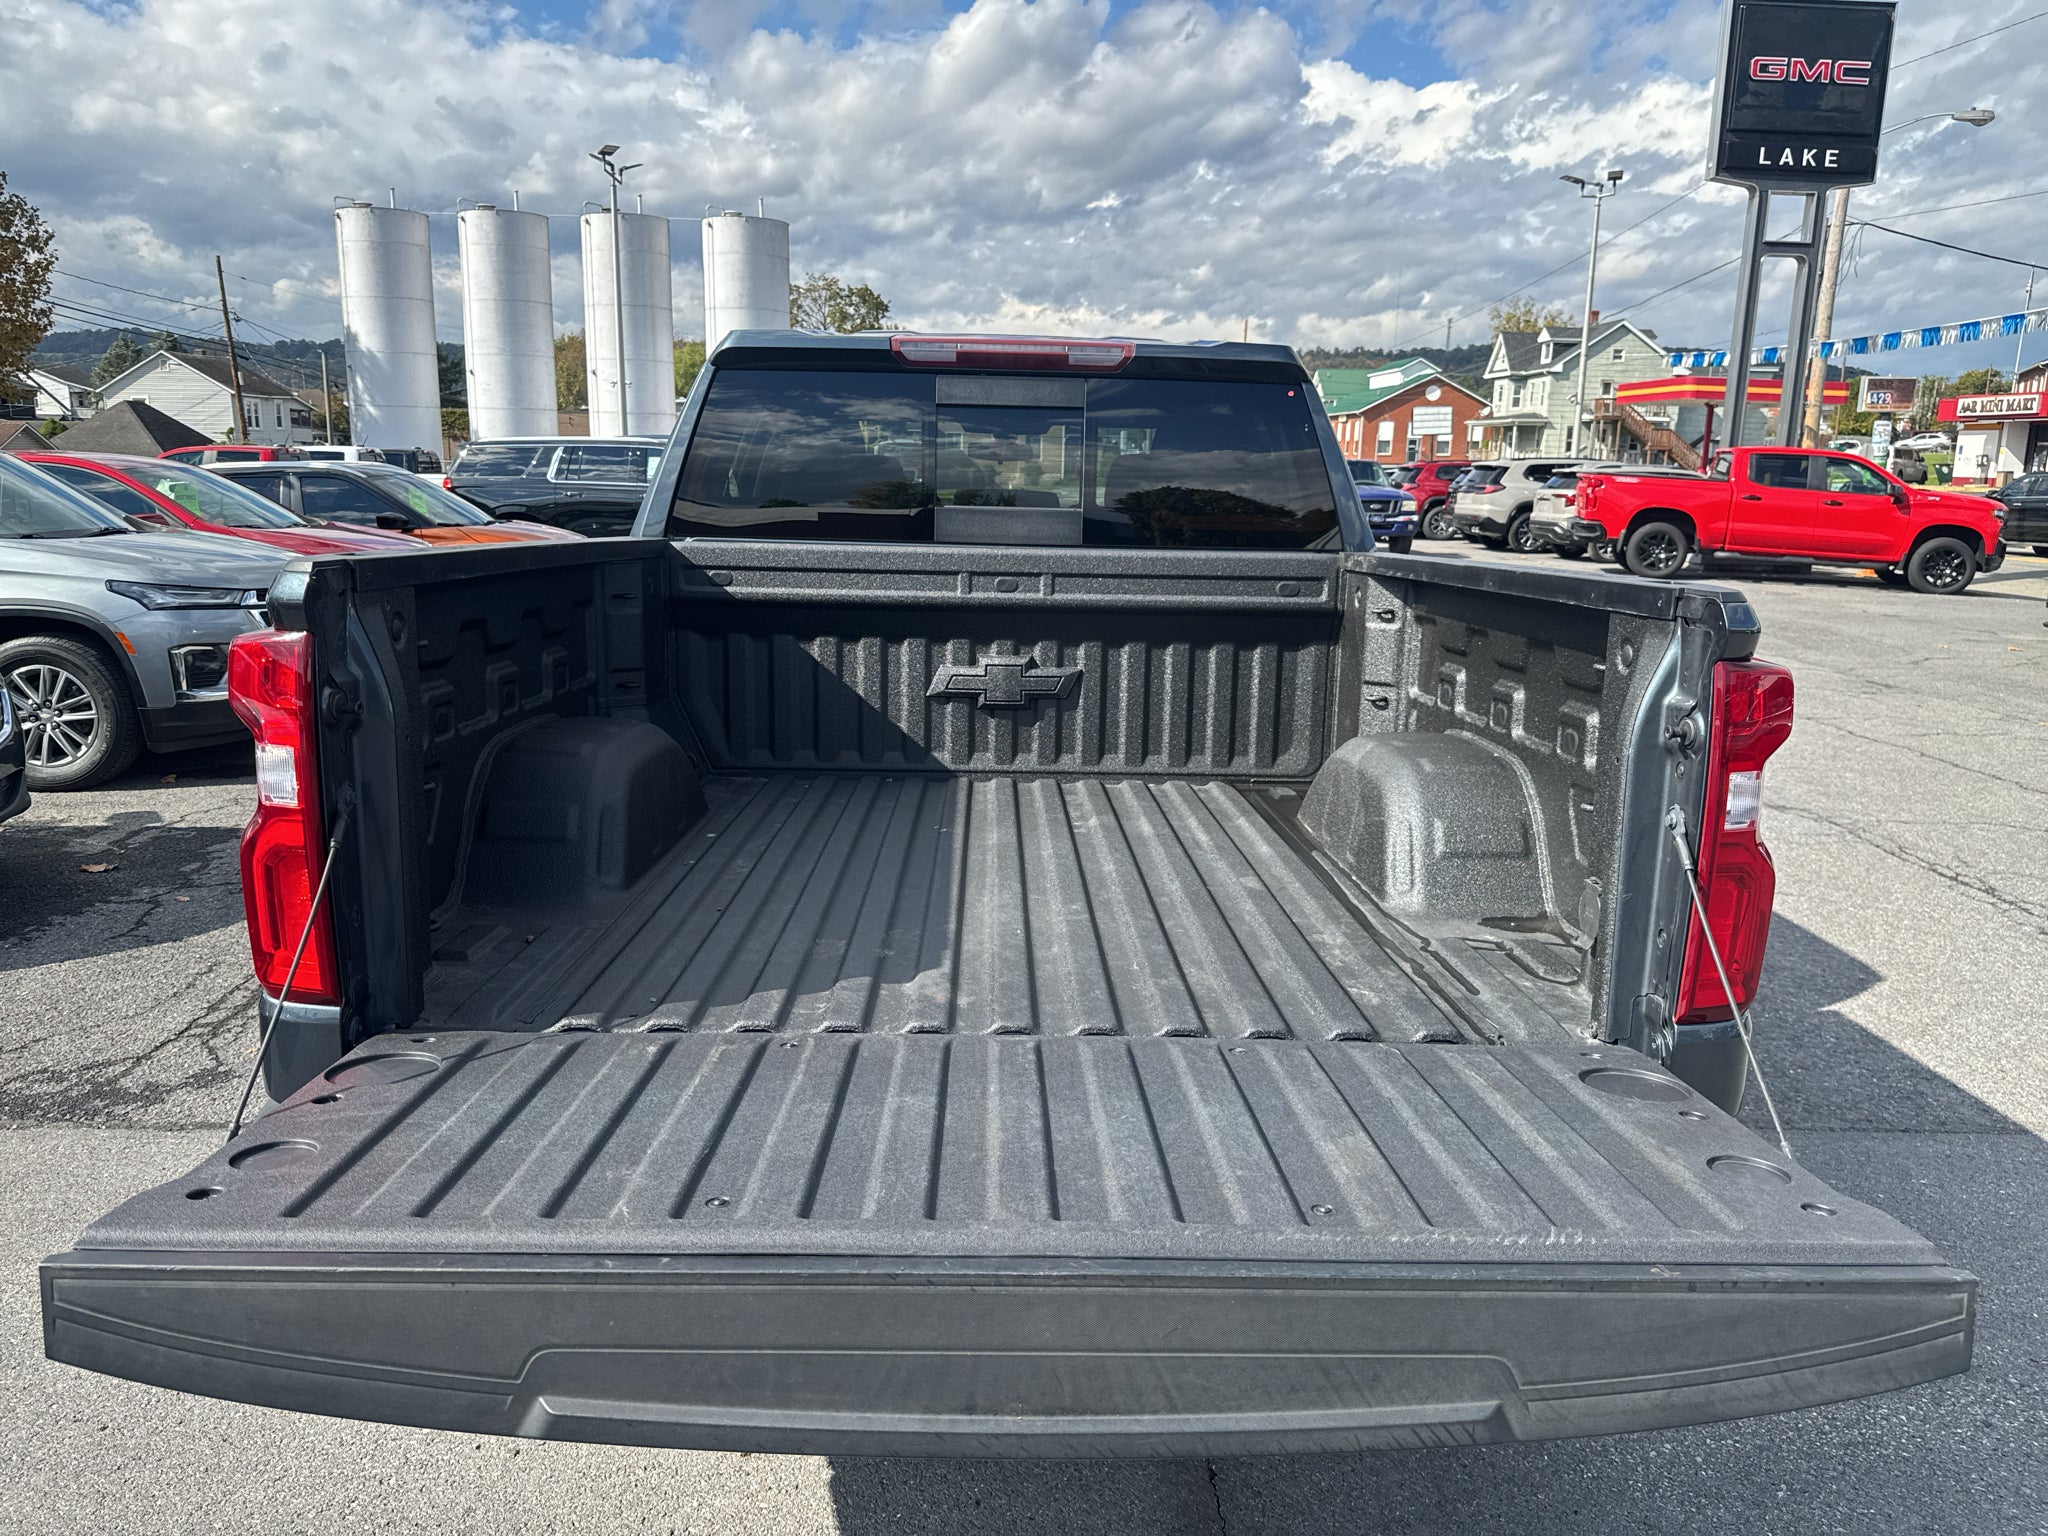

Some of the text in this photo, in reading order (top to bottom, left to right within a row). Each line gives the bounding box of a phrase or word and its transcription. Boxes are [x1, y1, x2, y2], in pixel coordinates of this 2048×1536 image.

[1750, 56, 1872, 85] GMC
[1758, 146, 1839, 167] LAKE
[1980, 399, 2003, 413] MINI
[2005, 397, 2036, 411] MART
